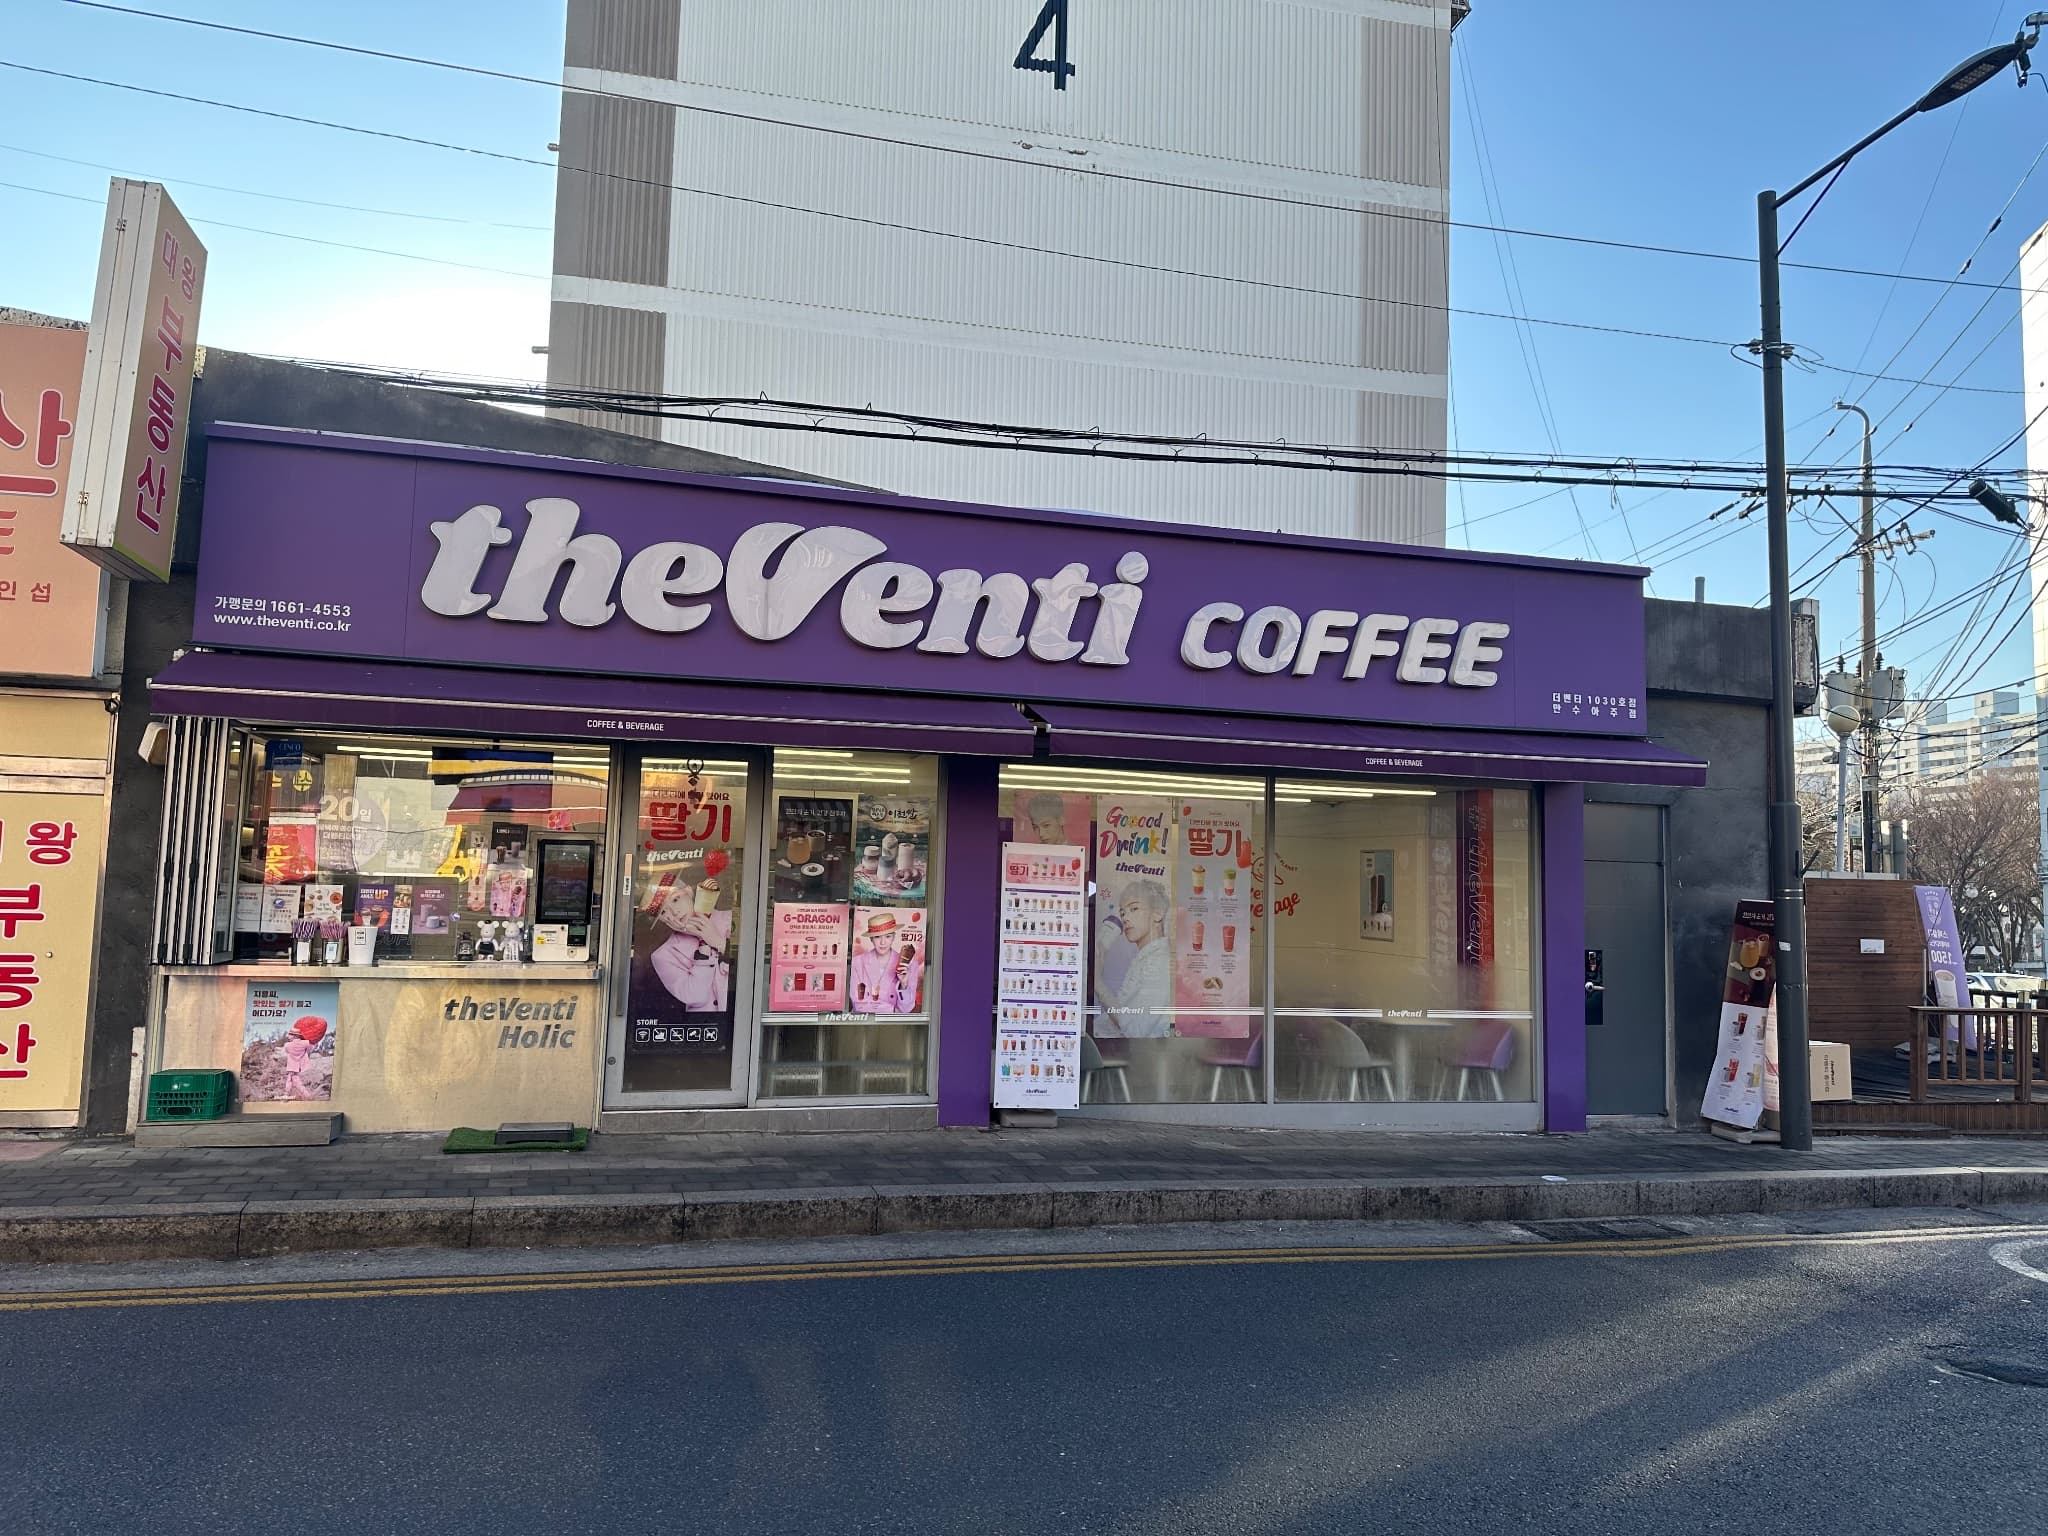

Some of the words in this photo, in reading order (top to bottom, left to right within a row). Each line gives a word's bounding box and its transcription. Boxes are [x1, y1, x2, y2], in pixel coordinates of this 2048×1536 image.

[1012, 0, 1076, 91] 4
[420, 497, 1149, 666] theVenti
[1180, 601, 1511, 688] COFFEE
[214, 596, 267, 612] 가맹문의
[270, 600, 351, 617] 1661-4553
[214, 613, 352, 632] www.theventi.co.kr
[1552, 692, 1582, 704] 더벤티
[587, 719, 617, 729] COFFEE
[617, 721, 624, 729] &
[625, 721, 665, 732] BEVERAGE
[1365, 757, 1388, 766] COFFEE
[1394, 758, 1424, 767] BEVERAGE
[650, 802, 732, 843] 딸기
[26, 820, 79, 865] 왕
[1099, 827, 1169, 859] Drink!
[1187, 828, 1242, 858] 딸기
[646, 848, 704, 862] theVenti
[1115, 861, 1165, 877] theVenti
[374, 889, 389, 899] UP
[783, 913, 841, 924] G-DRAGON
[252, 1009, 287, 1017] 어디가요?
[444, 995, 579, 1021] theVenti
[1106, 1006, 1145, 1014] theVenti
[1387, 1009, 1423, 1018] theVenti
[636, 1018, 659, 1026] STORE
[825, 1012, 869, 1021] theVenti
[498, 1024, 577, 1049] Holic
